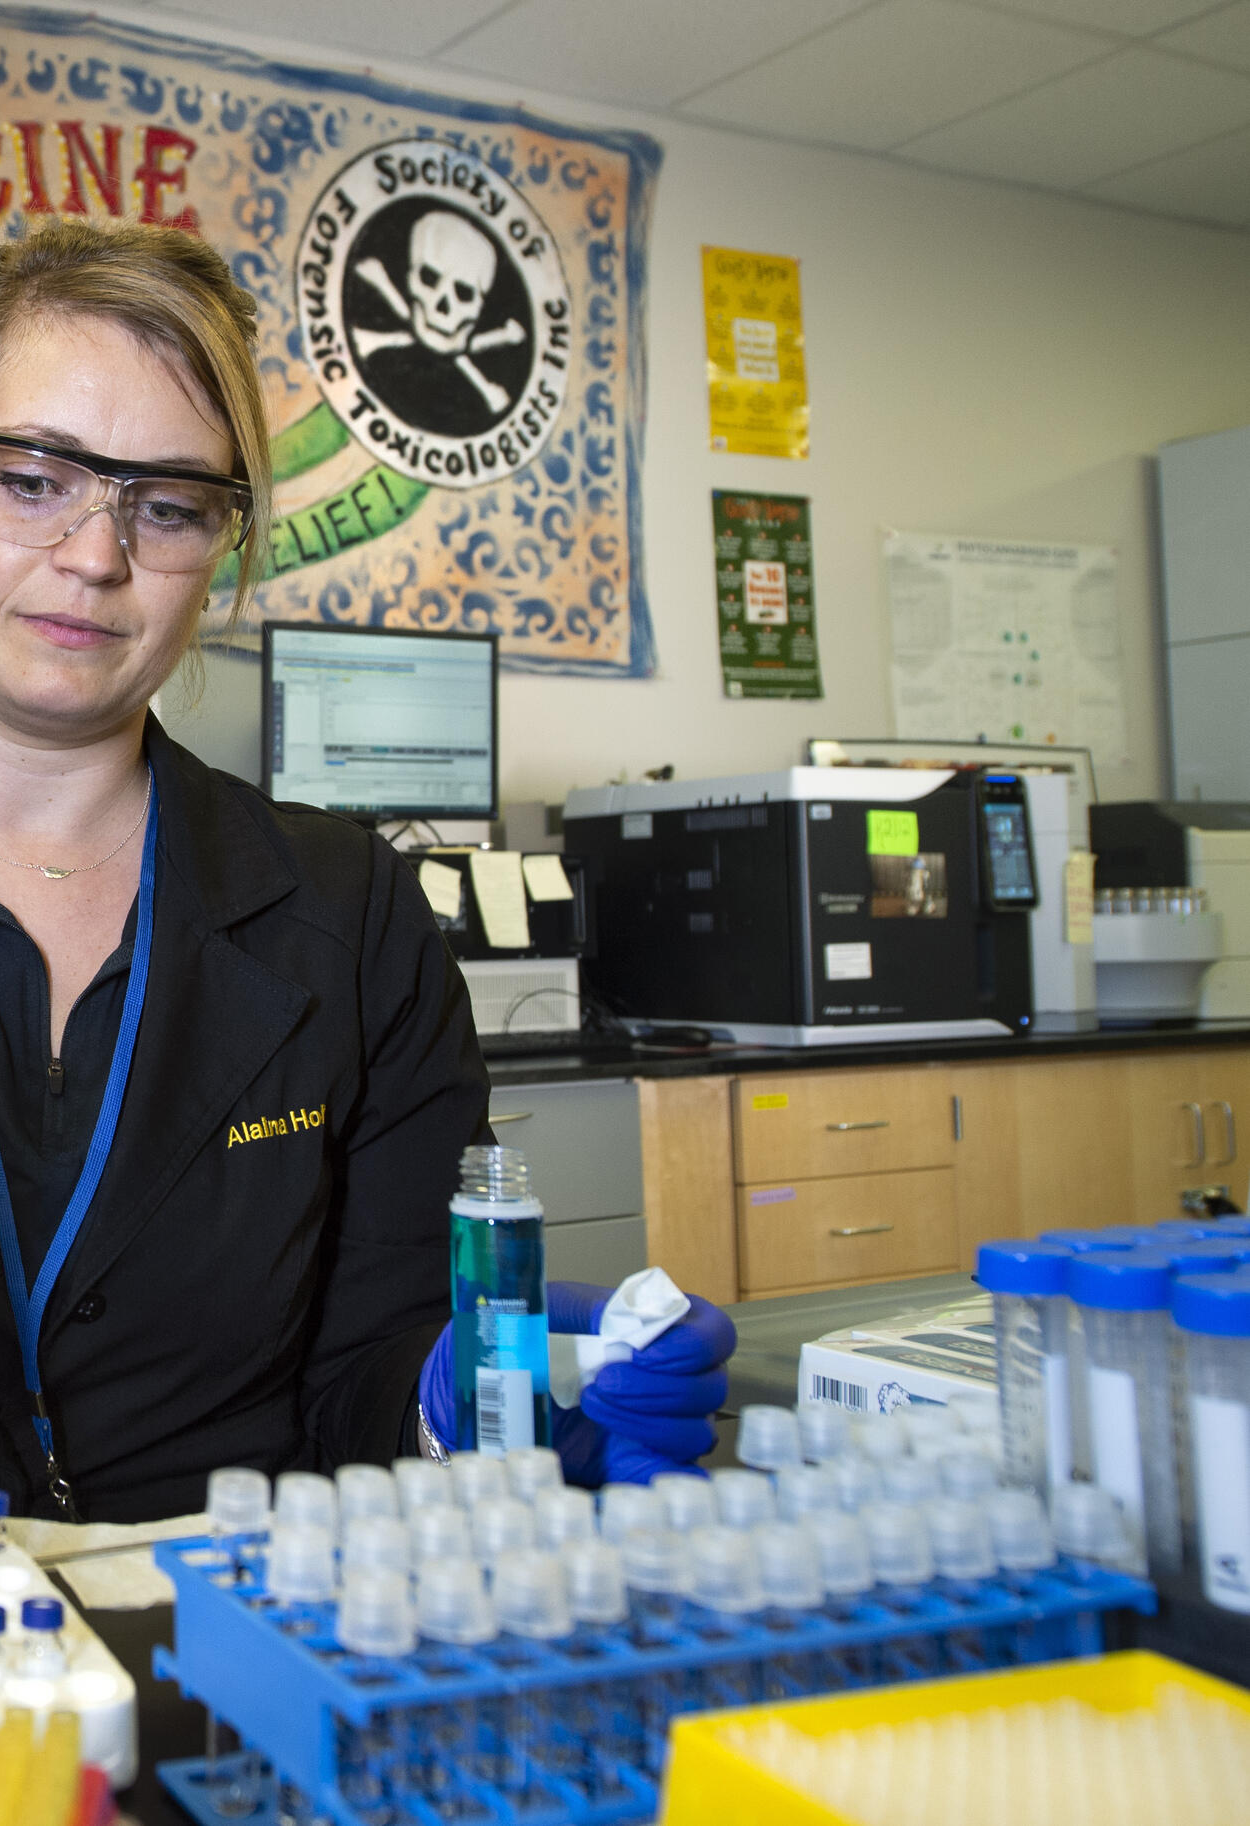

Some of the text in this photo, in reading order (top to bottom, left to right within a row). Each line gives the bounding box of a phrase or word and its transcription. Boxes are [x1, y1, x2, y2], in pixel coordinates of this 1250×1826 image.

[373, 153, 545, 260] Society of
[302, 188, 569, 476] Forensic Toxicologists Inc
[270, 473, 404, 574] ELIEF!
